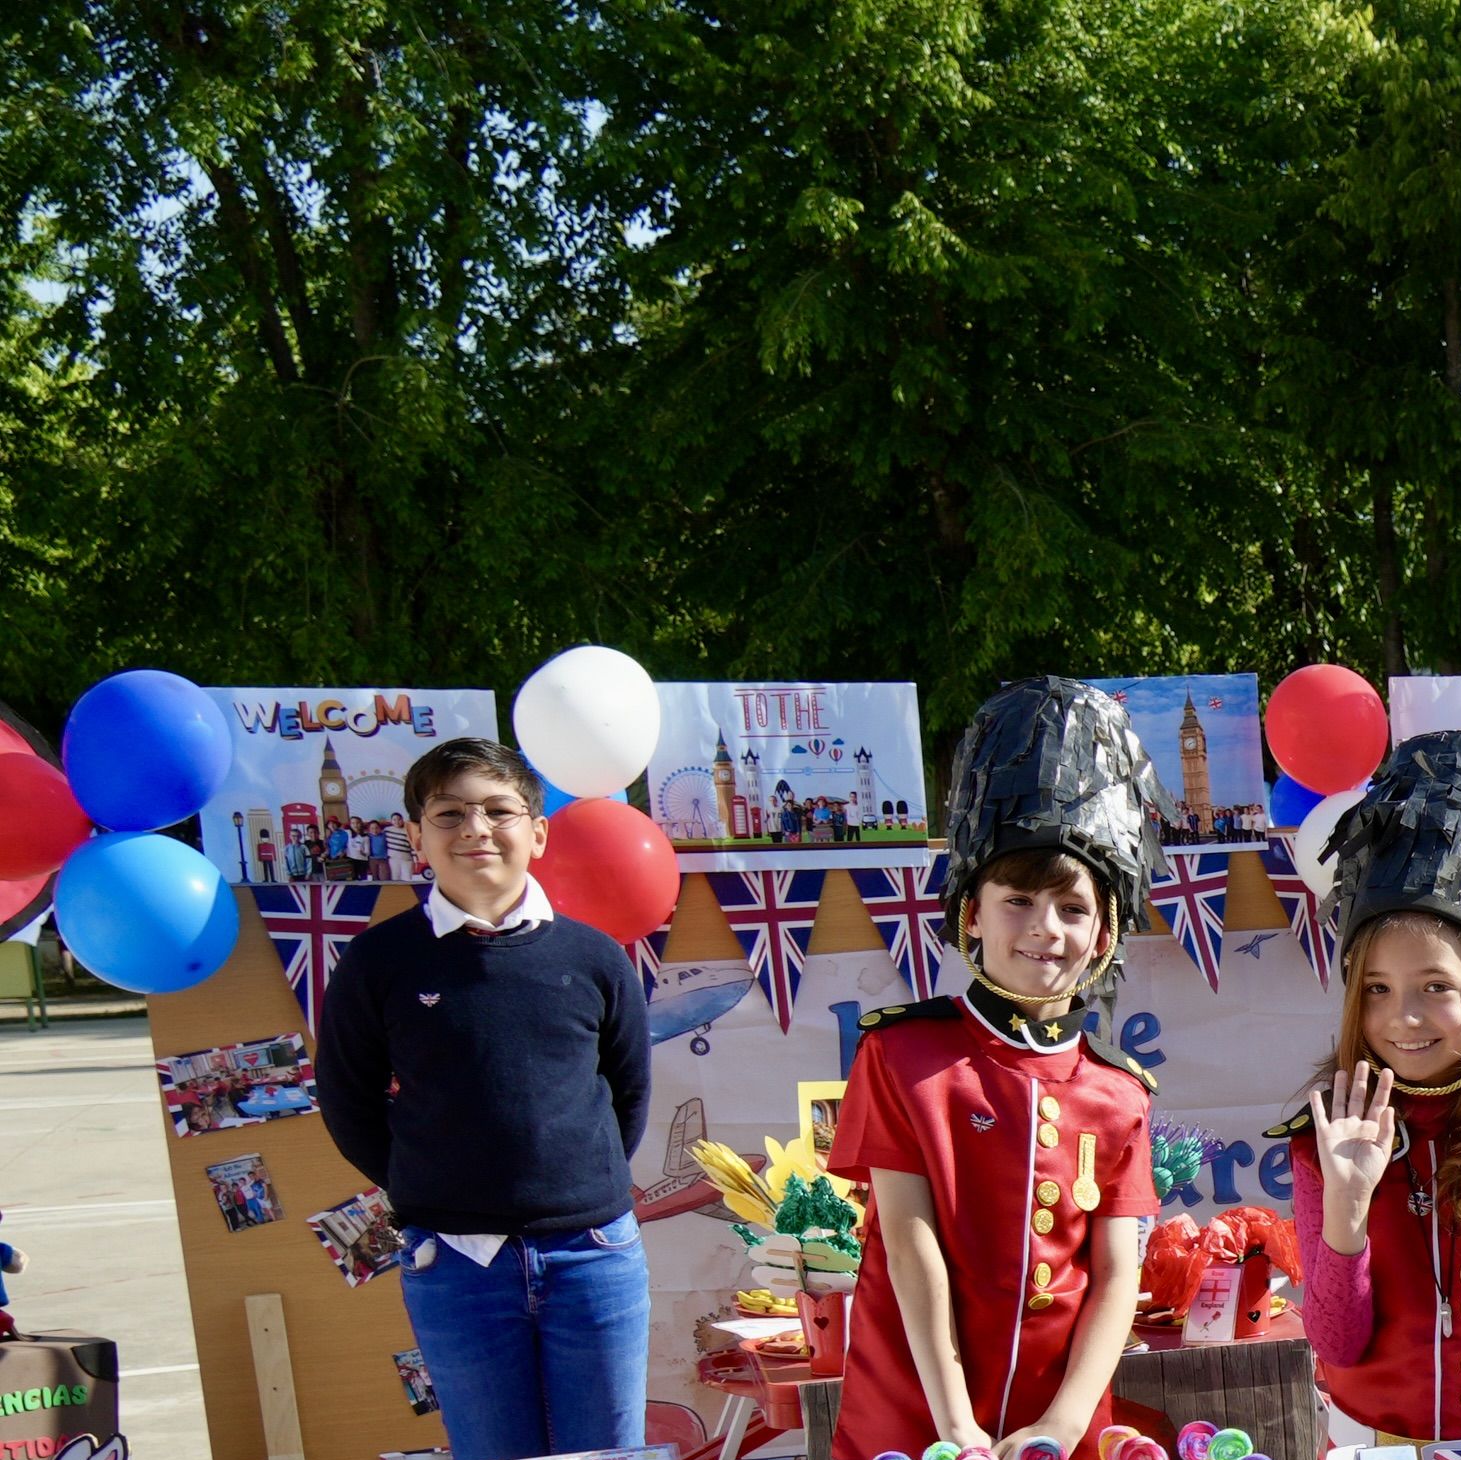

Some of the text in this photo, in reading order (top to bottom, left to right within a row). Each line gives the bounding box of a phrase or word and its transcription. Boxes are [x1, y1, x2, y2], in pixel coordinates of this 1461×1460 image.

[233, 694, 437, 740] WELCOME
[734, 692, 830, 730] TO THE
